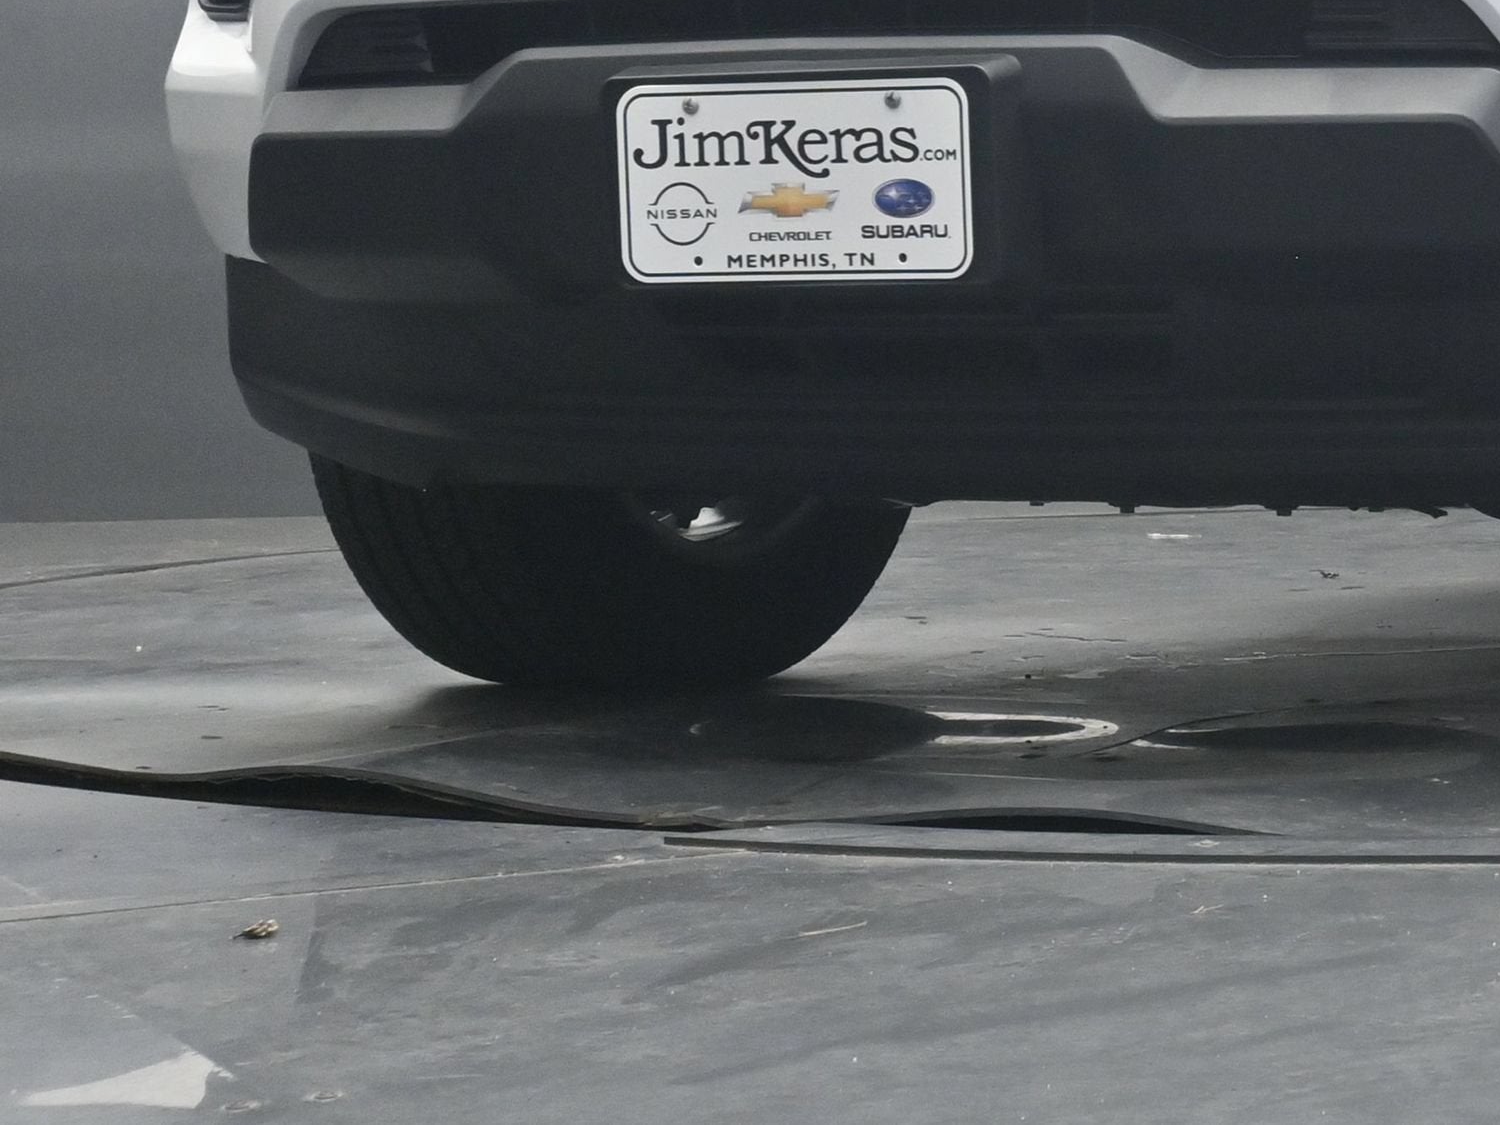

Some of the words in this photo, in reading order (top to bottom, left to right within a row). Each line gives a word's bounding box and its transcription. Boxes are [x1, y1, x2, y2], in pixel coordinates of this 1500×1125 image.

[646, 207, 718, 220] NISSAN
[749, 231, 832, 242] CHEVROLET
[861, 224, 949, 239] SUBARU
[727, 253, 836, 269] MEMPHIS,
[844, 252, 875, 266] TN
